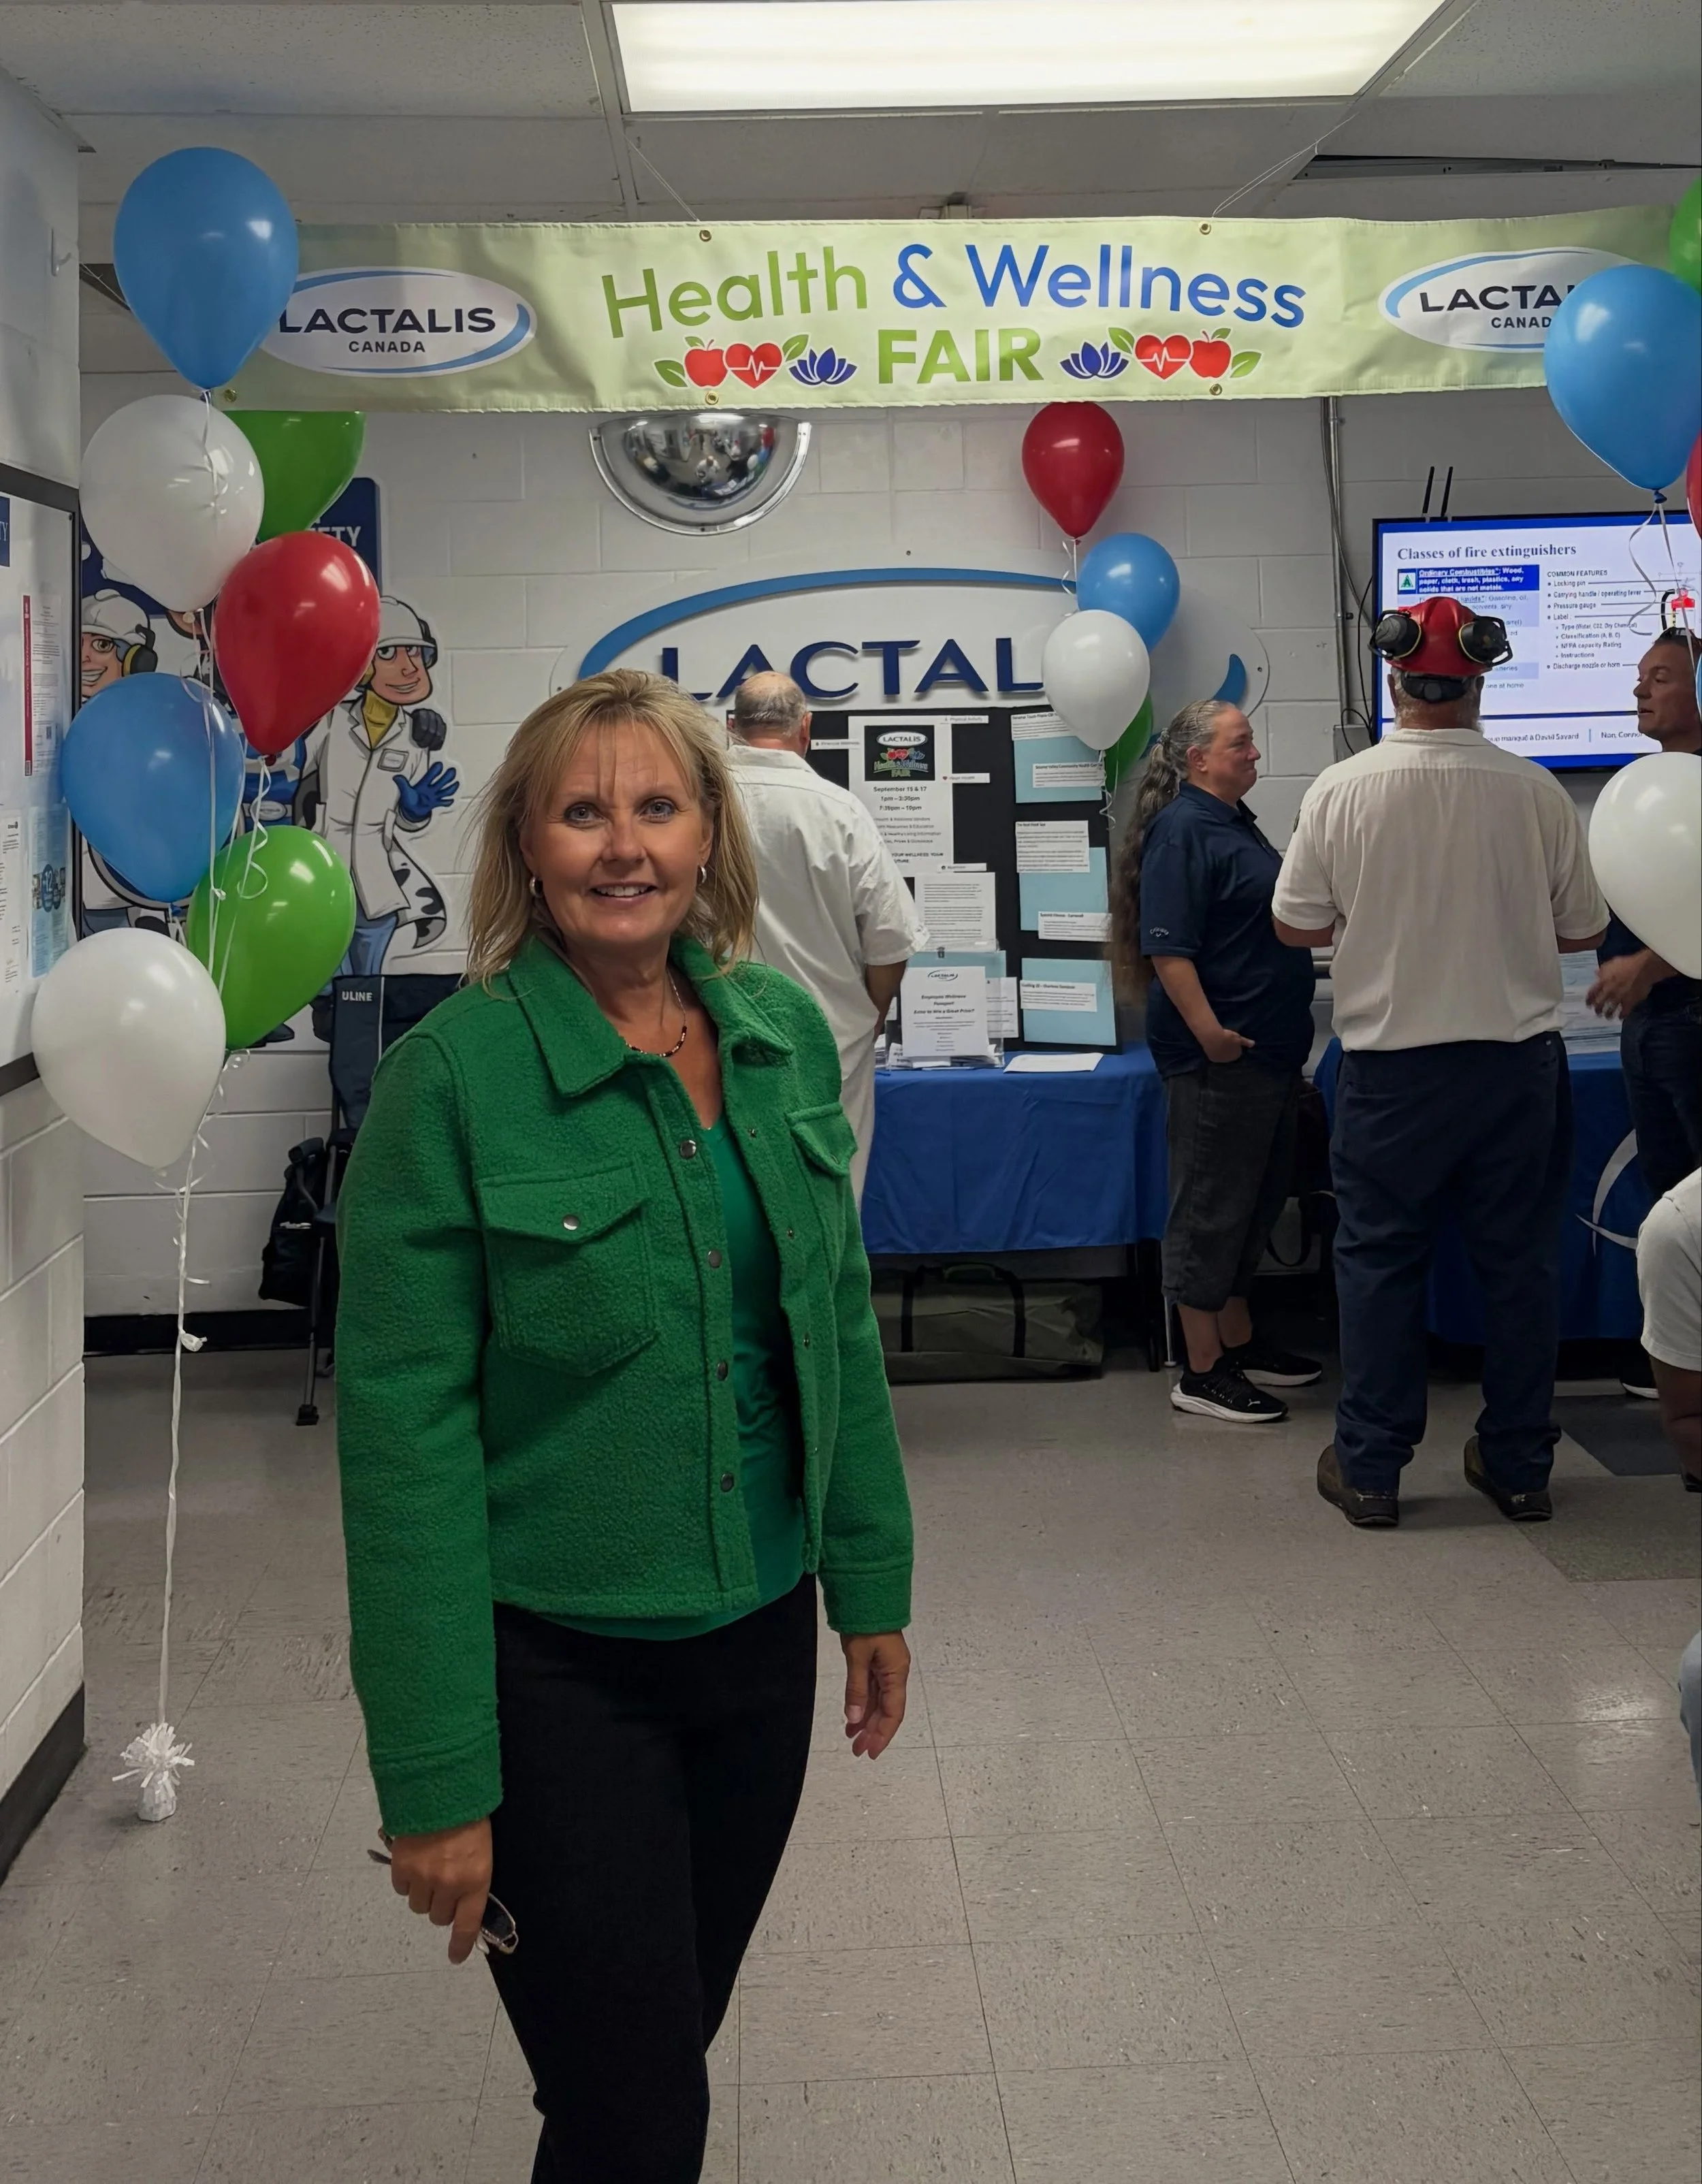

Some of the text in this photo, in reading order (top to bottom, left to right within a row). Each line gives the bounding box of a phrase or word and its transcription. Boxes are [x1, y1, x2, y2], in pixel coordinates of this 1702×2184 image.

[602, 244, 1306, 338] Health & Wellness
[1419, 285, 1575, 312] LACTA
[279, 308, 496, 334] LACTALIS
[1491, 317, 1552, 328] CANAD
[349, 341, 426, 353] CANADA
[878, 327, 1044, 383] FAIR
[1398, 544, 1577, 560] Classes of fire extinguishers
[662, 638, 1044, 702] LACTAL
[342, 991, 372, 1001] ULINE
